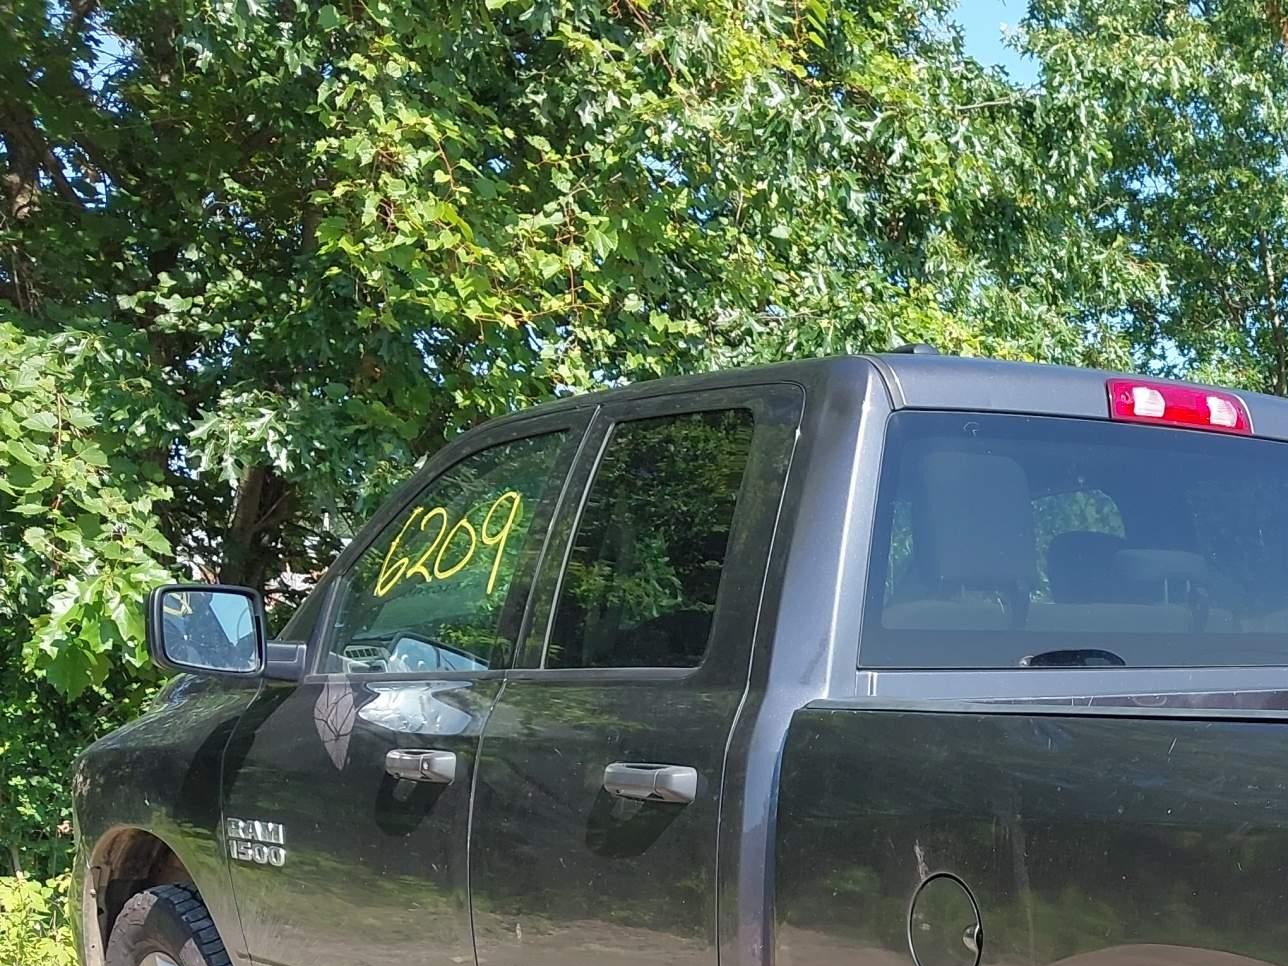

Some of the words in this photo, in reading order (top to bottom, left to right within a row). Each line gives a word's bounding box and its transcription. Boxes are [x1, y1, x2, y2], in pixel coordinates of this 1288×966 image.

[373, 490, 522, 597] 6209
[227, 817, 285, 845] RAM
[229, 839, 287, 867] 1500
